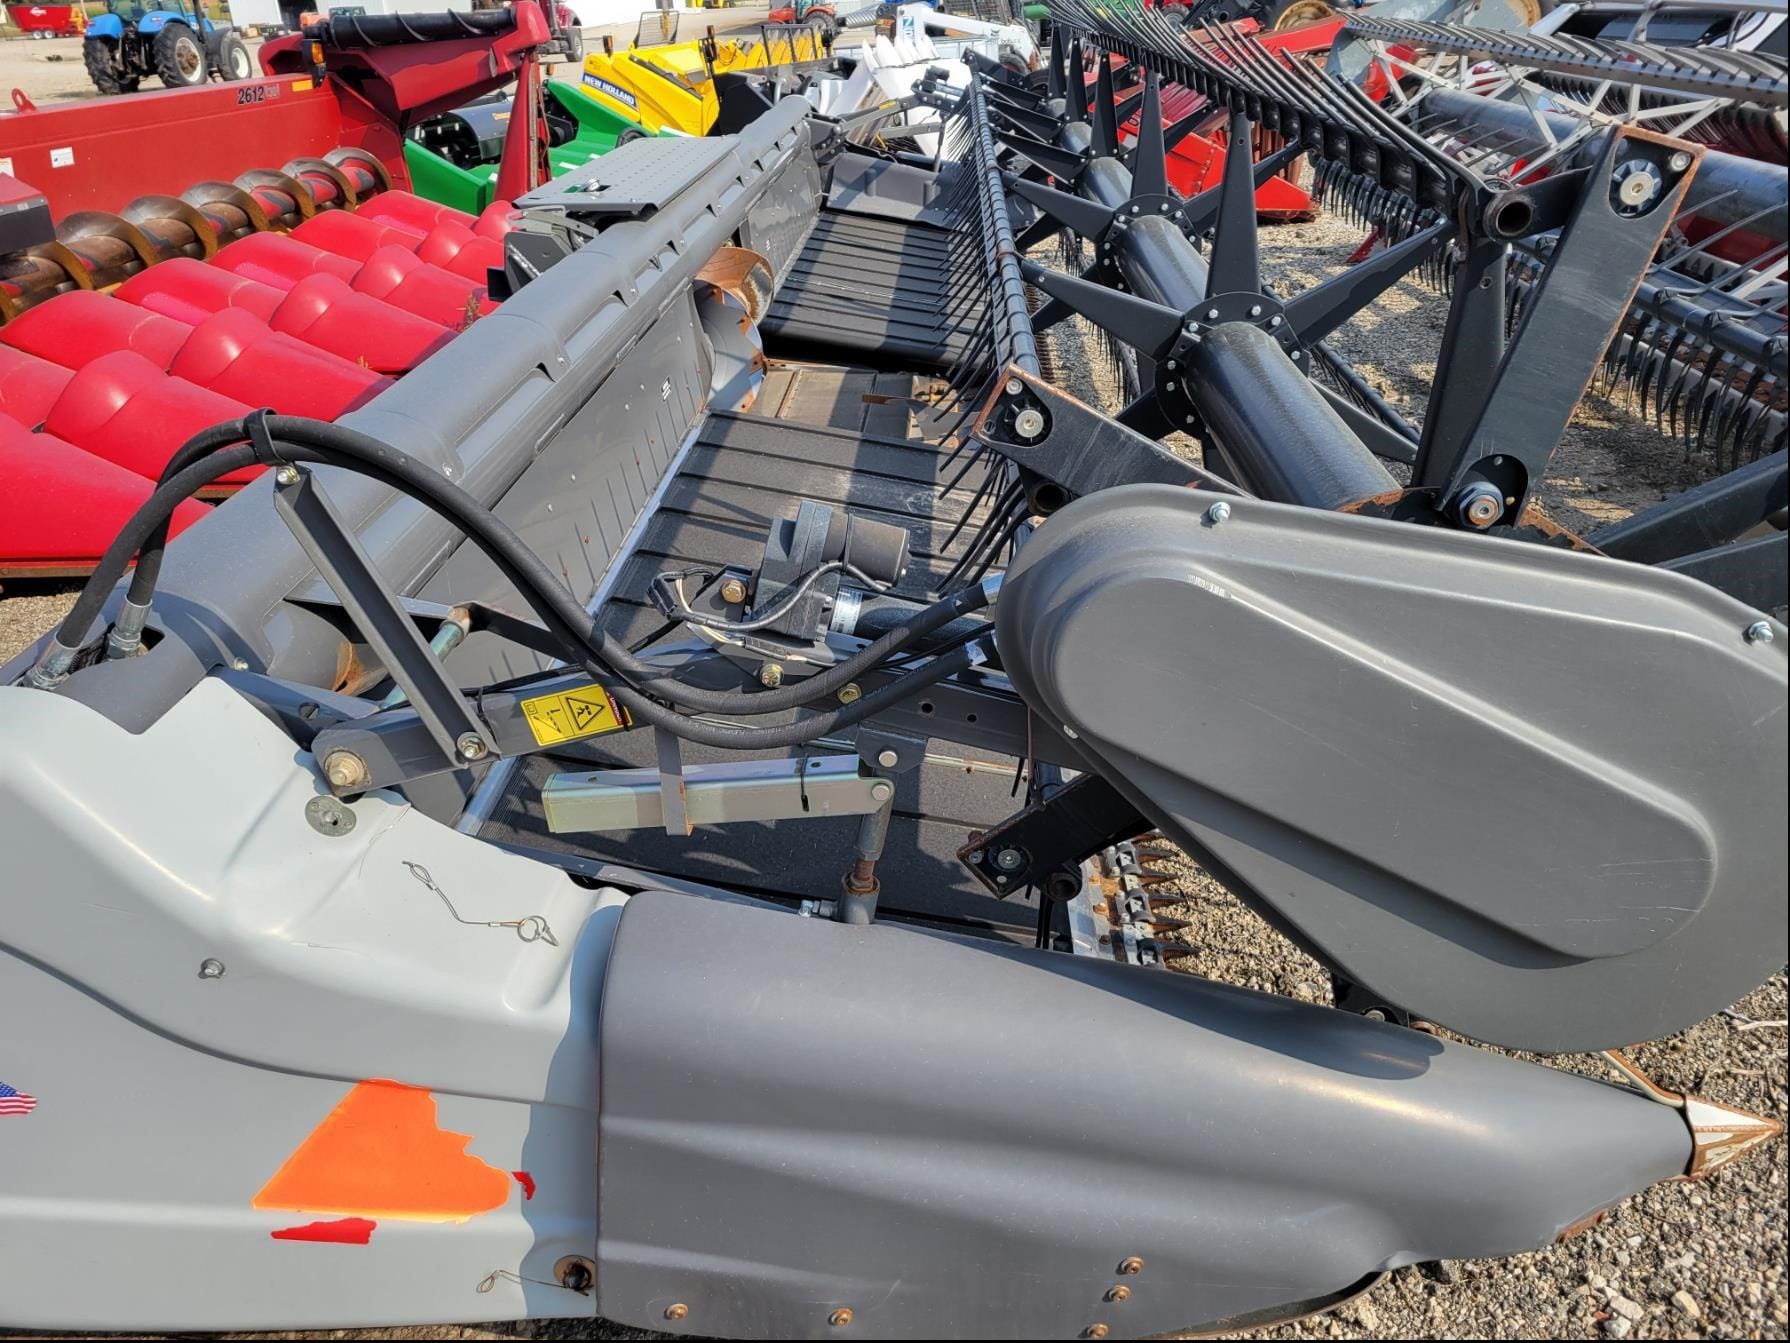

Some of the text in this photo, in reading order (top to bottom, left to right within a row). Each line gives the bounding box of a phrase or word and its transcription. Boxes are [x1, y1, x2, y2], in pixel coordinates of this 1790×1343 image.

[238, 86, 265, 105] 2612
[584, 74, 635, 105] NEW HOLLAND
